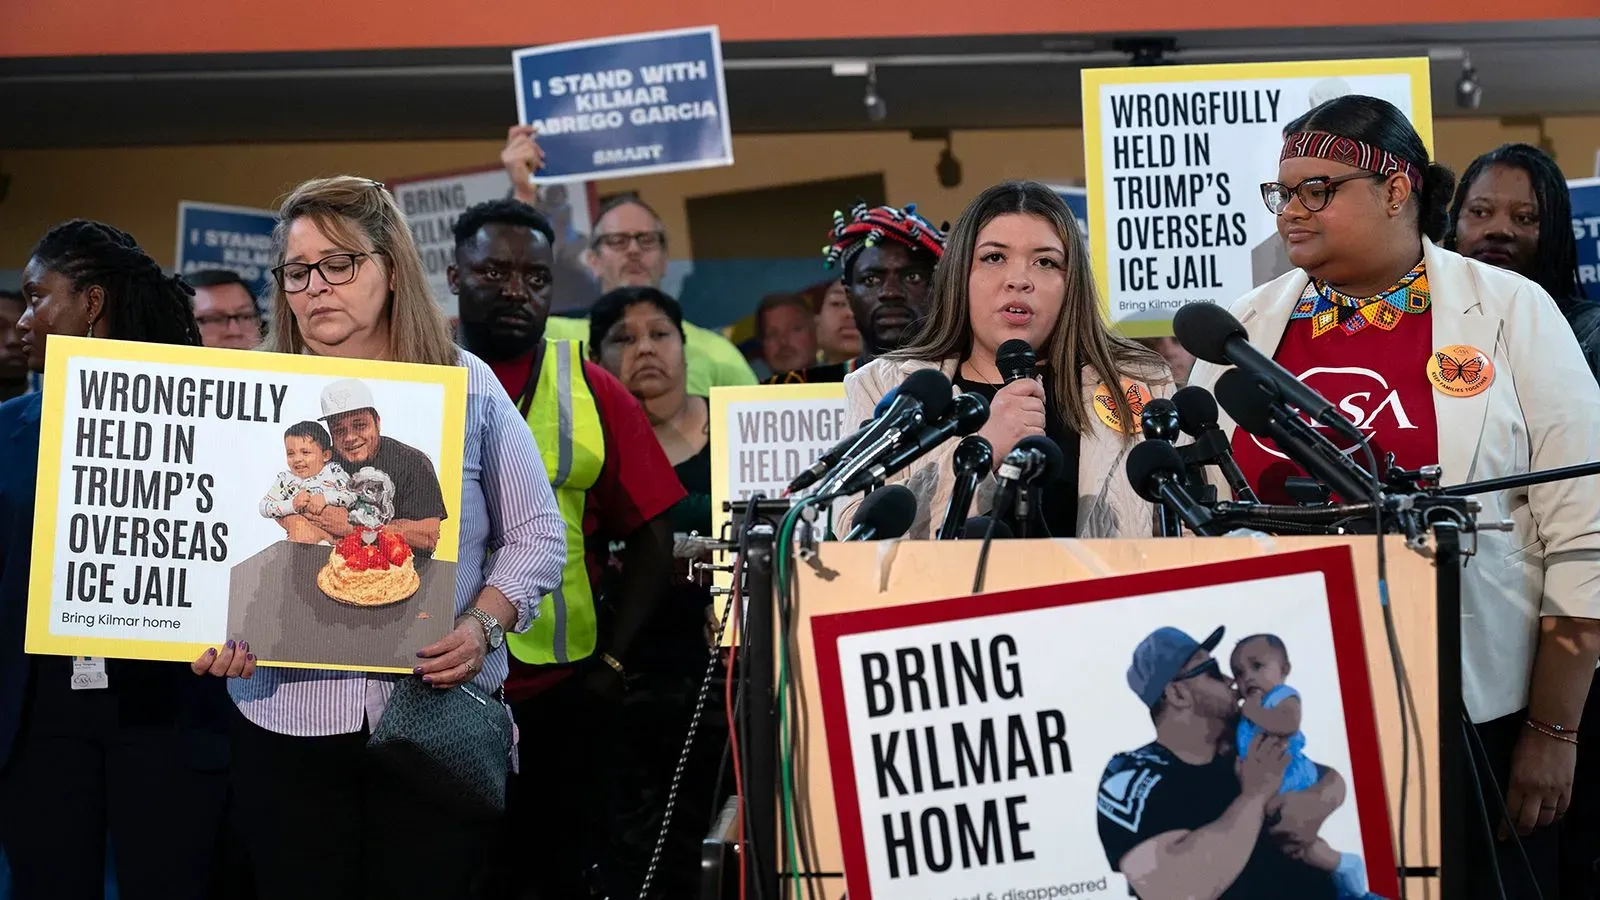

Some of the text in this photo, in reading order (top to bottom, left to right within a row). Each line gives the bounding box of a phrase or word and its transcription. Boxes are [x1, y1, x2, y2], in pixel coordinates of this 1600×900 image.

[532, 60, 708, 98] I STAND WITH
[576, 86, 669, 112] KILMAR
[1111, 89, 1281, 128] WRONGFULLY
[531, 101, 718, 136] ABREGO GARCIA
[593, 145, 664, 166] SMART
[1113, 132, 1211, 169] HELD IN
[403, 184, 466, 216] BRING
[1113, 172, 1231, 210] TRUMP'S
[1117, 212, 1247, 251] OVERSEAS
[1119, 254, 1223, 292] ICE JAIL
[1119, 301, 1146, 312] Bring
[1149, 299, 1181, 310] Kilmar
[79, 369, 288, 423] WRONGFULLY
[1439, 382, 1464, 393] FAMILIES
[75, 417, 195, 465] HELD IN
[738, 407, 845, 444] WRONGF
[739, 449, 801, 484] HELD
[71, 465, 215, 513] TRUMP'S
[69, 513, 229, 562] OVERSEAS
[65, 561, 193, 608] ICE JAIL
[61, 612, 181, 629] Bring Kilmar home
[860, 633, 1024, 719] BRING
[871, 708, 1073, 799] KILMAR
[882, 794, 1036, 879] HOME
[1001, 875, 1107, 900] disappeared
